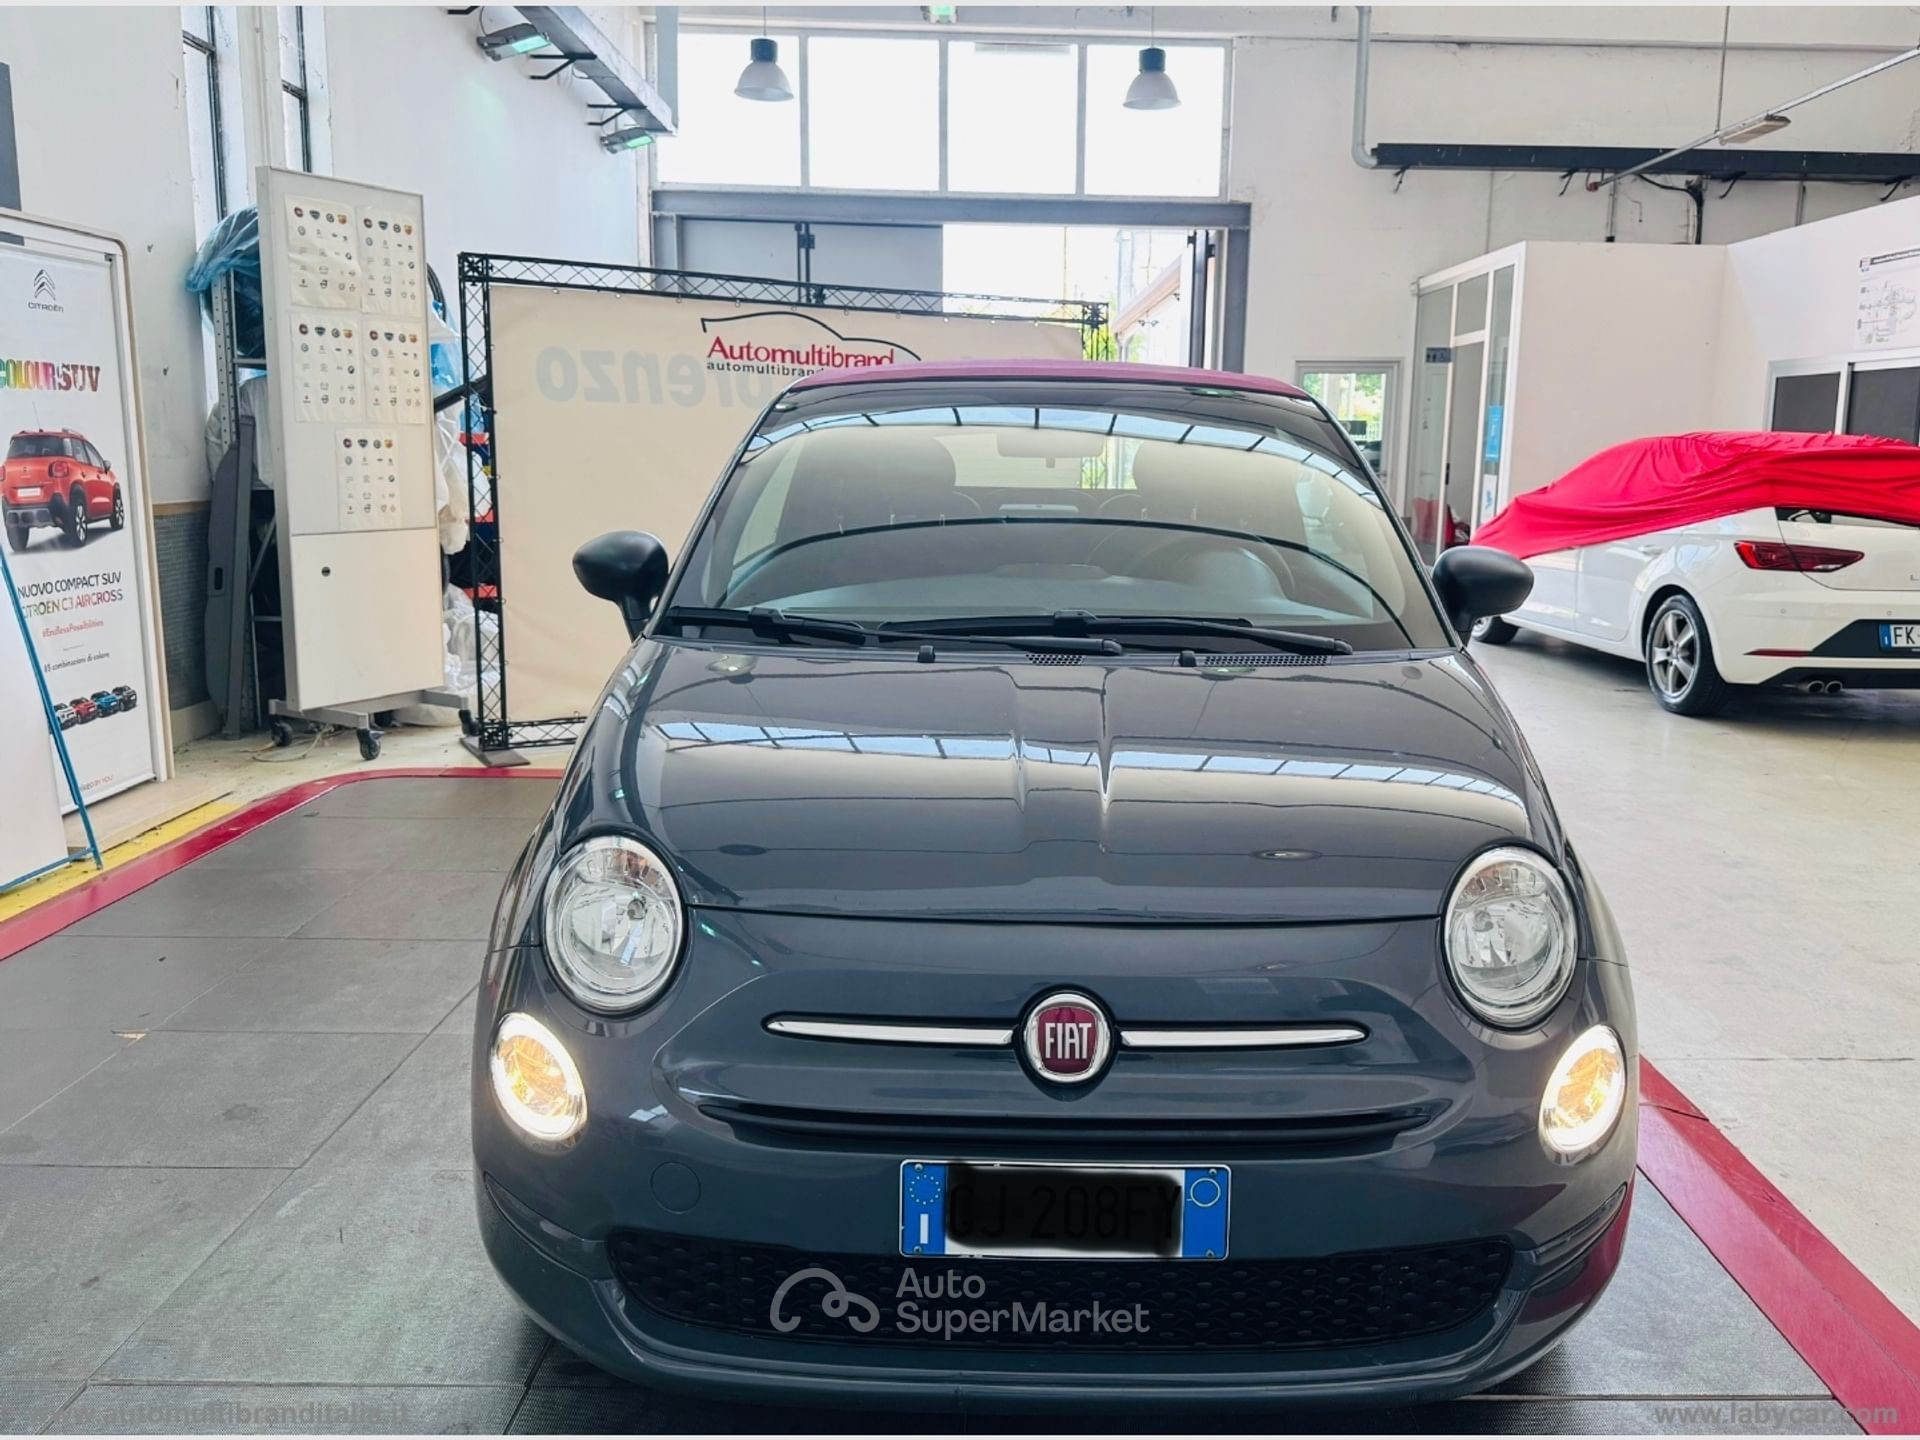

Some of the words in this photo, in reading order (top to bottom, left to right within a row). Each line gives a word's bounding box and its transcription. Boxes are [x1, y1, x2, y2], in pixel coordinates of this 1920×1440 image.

[707, 336, 895, 368] Automultibrand
[706, 360, 824, 378] automultibran
[17, 581, 53, 599] NUOVO
[55, 574, 99, 593] COMPACT
[101, 571, 121, 586] SUV
[75, 588, 124, 610] AIRCROSS
[1044, 1022, 1092, 1059] FIAT
